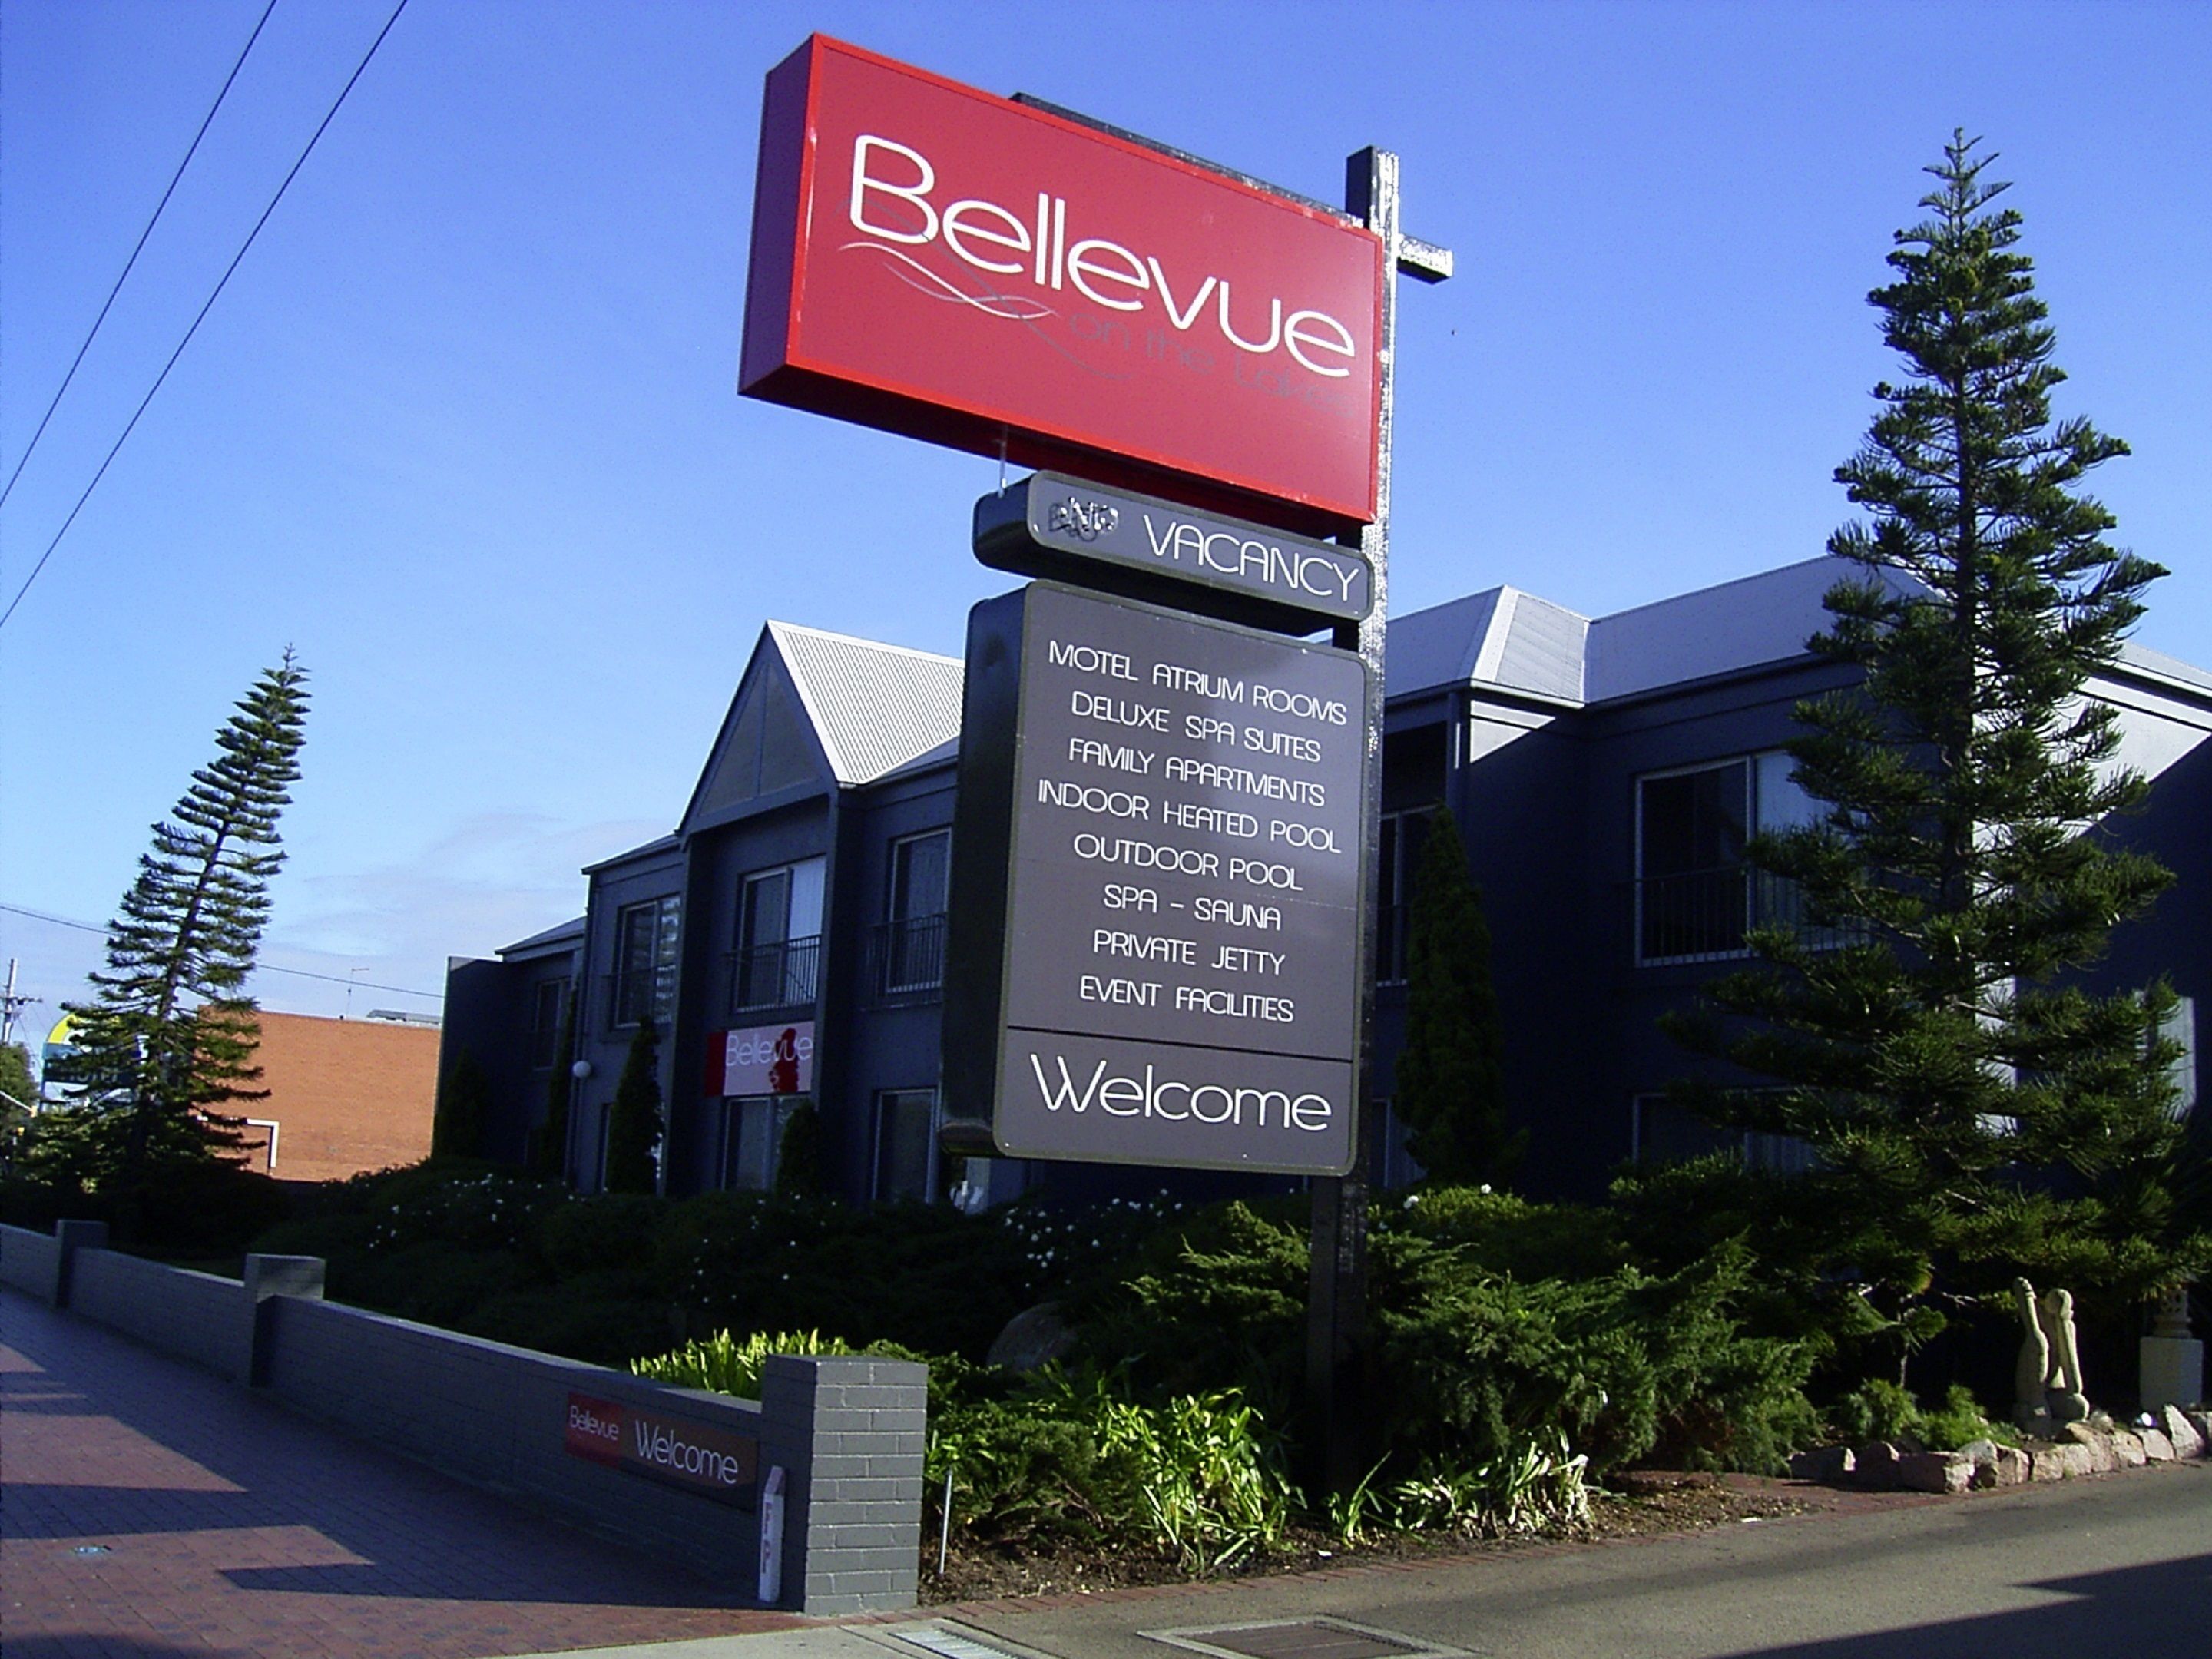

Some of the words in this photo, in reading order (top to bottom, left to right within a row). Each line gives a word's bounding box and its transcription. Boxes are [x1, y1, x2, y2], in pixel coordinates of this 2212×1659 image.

[849, 134, 1356, 378] Bellevue
[1068, 312, 1131, 351] on
[1146, 328, 1217, 376] the
[1143, 515, 1359, 601] VACANCY
[1049, 640, 1139, 681] MOTEL
[1153, 664, 1244, 704] ATRIUM
[1253, 685, 1346, 726] ROOMS
[1071, 690, 1170, 733] DELUXE
[1185, 715, 1235, 746] SPA
[1243, 727, 1320, 762] SUITES
[1069, 738, 1155, 774] FAMILY
[1165, 756, 1325, 807] APARTMENTS
[1038, 779, 1150, 820] INDOOR
[1164, 800, 1258, 838] HEATED
[1270, 820, 1341, 853] POOL
[1074, 833, 1219, 877] OUTDOOR
[1230, 858, 1303, 891] POOL
[1103, 884, 1157, 913] SPA
[1194, 897, 1280, 931] SAUNA
[1094, 929, 1197, 965] PRIVATE
[1211, 946, 1285, 975] JETTY
[1081, 975, 1162, 1007] EVENT
[1175, 986, 1293, 1022] FACILITIES
[725, 1035, 813, 1067] Bellevue
[1031, 1054, 1332, 1131] Welcome
[569, 1405, 619, 1441] Bellevue
[634, 1419, 738, 1485] Welcome
